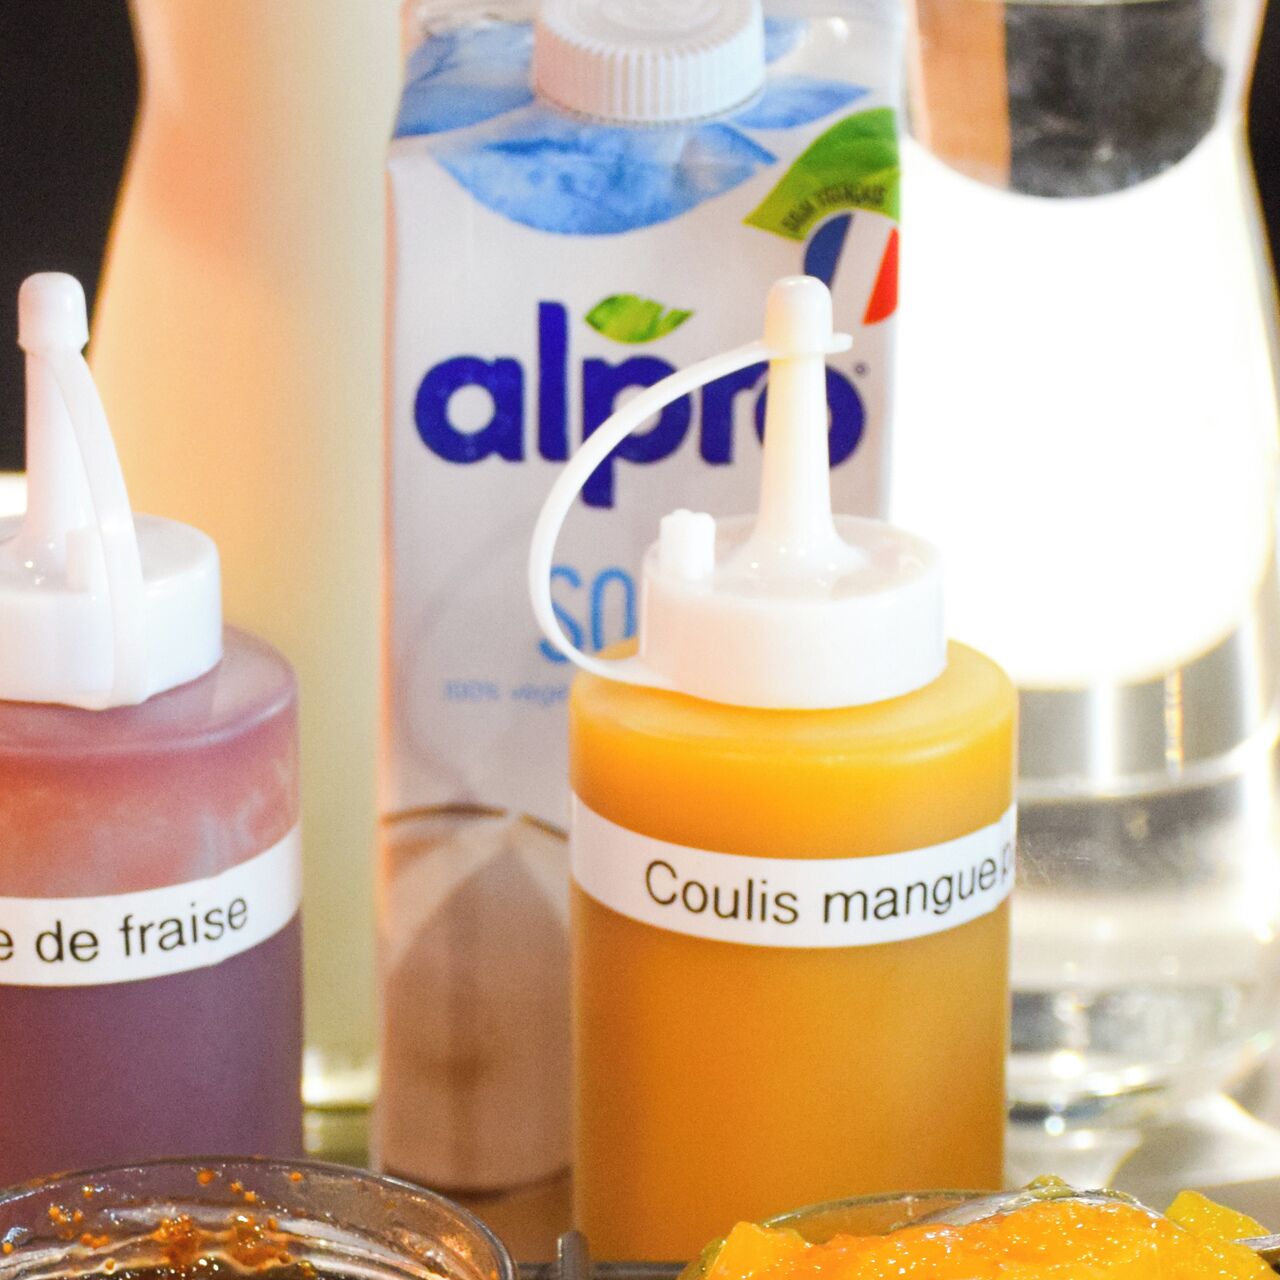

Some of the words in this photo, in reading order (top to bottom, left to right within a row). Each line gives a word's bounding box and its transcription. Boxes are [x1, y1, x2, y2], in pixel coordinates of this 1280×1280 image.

[414, 300, 866, 509] alpro
[644, 859, 800, 926] Coulis
[822, 856, 998, 925] mangue
[36, 920, 99, 963] de
[119, 896, 249, 957] fraise
